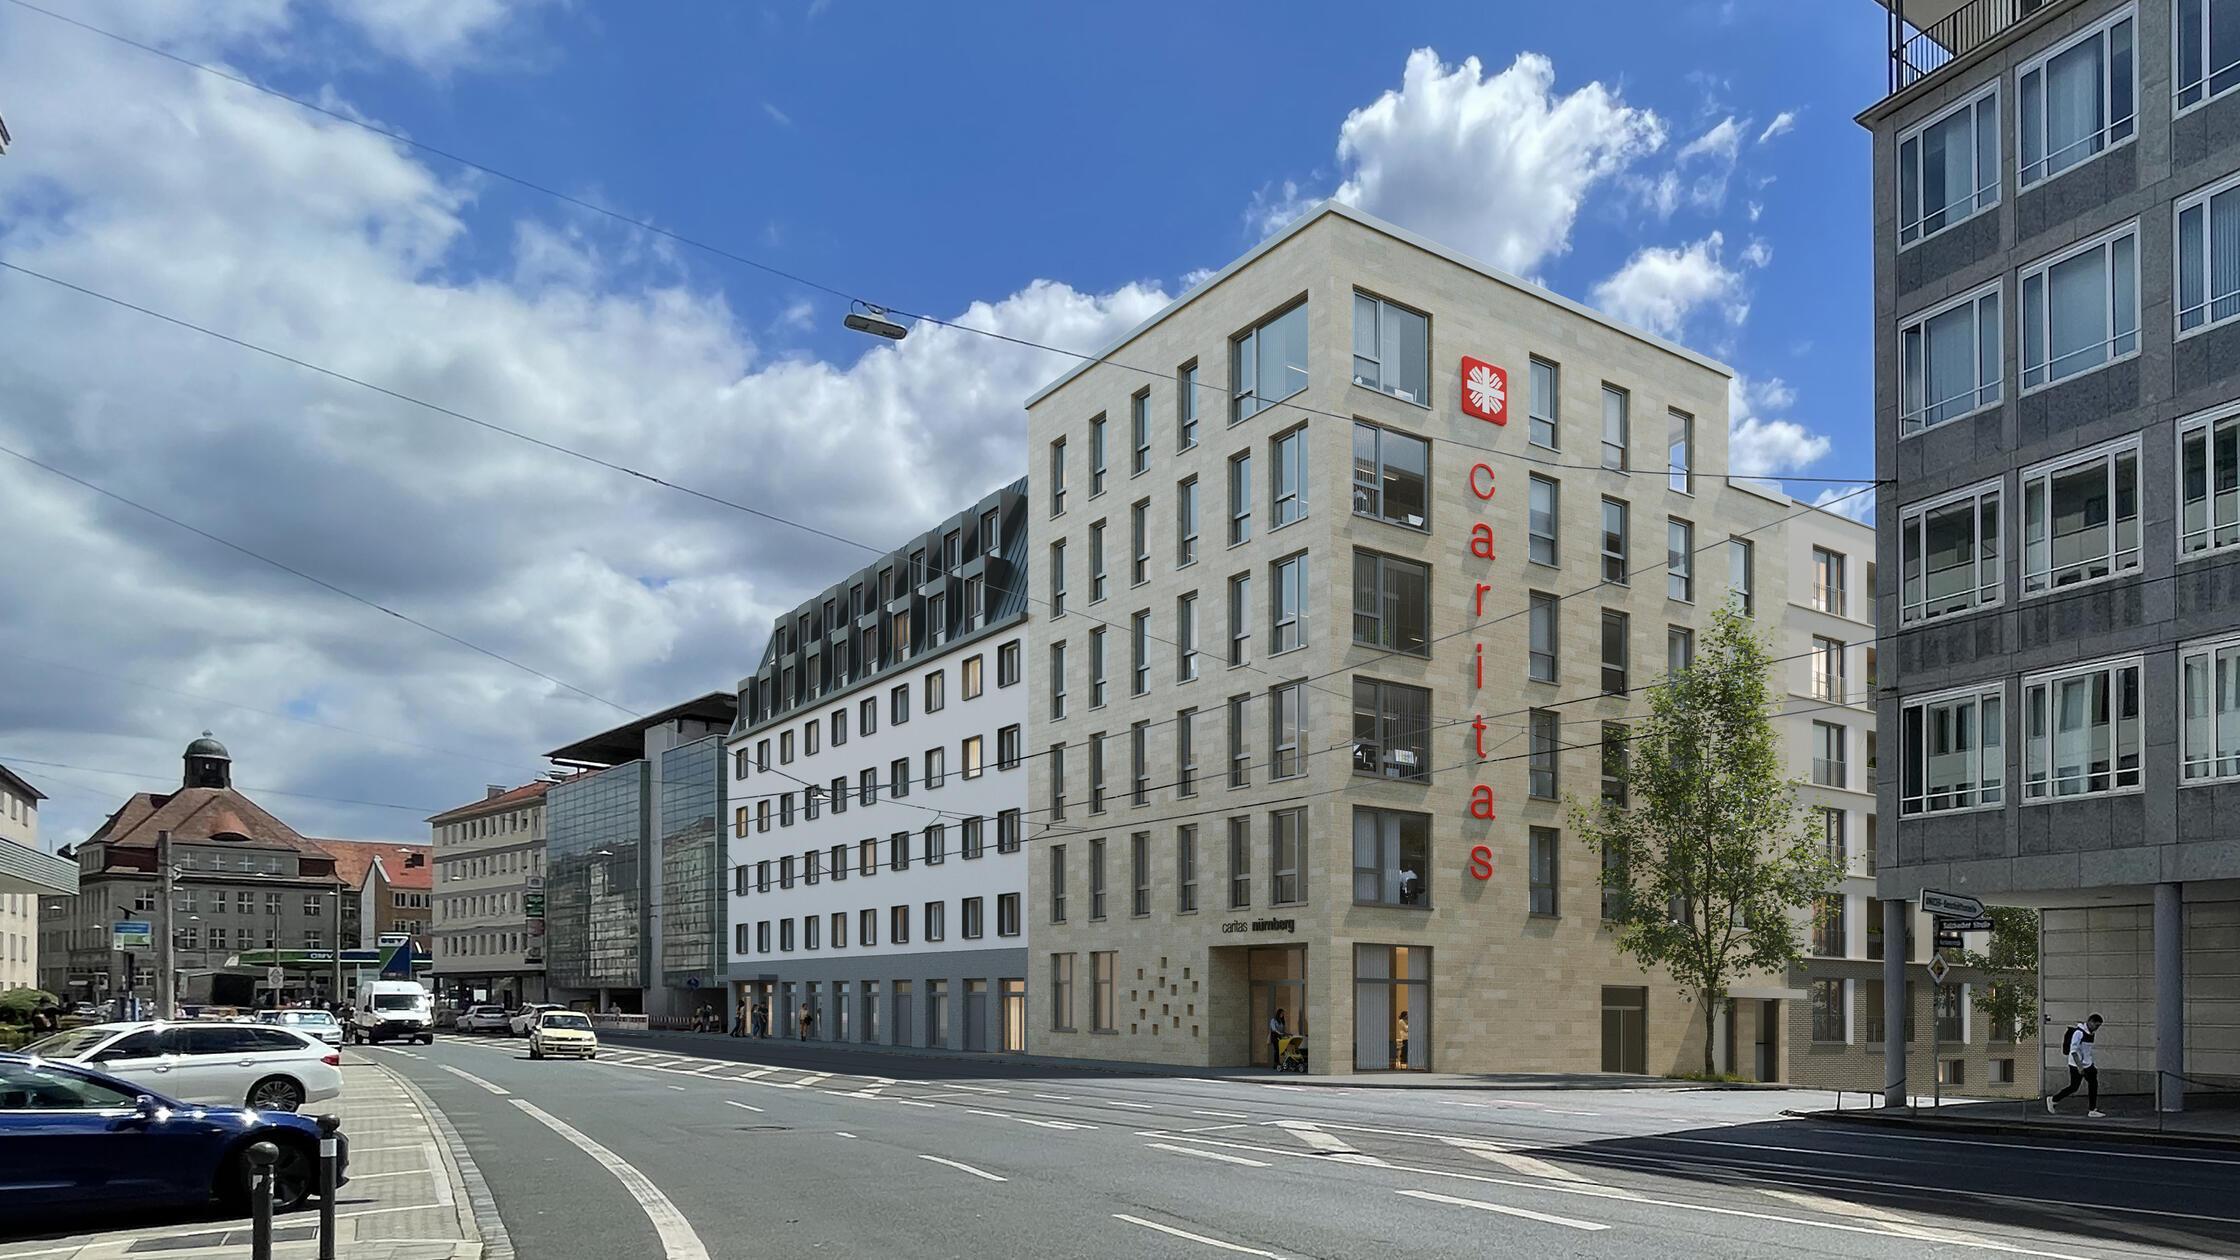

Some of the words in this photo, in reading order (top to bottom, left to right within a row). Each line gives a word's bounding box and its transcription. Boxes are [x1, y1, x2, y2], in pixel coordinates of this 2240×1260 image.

[1470, 463, 1496, 882] caritas
[1222, 920, 1248, 933] caritas
[1252, 917, 1295, 933] nürnberg
